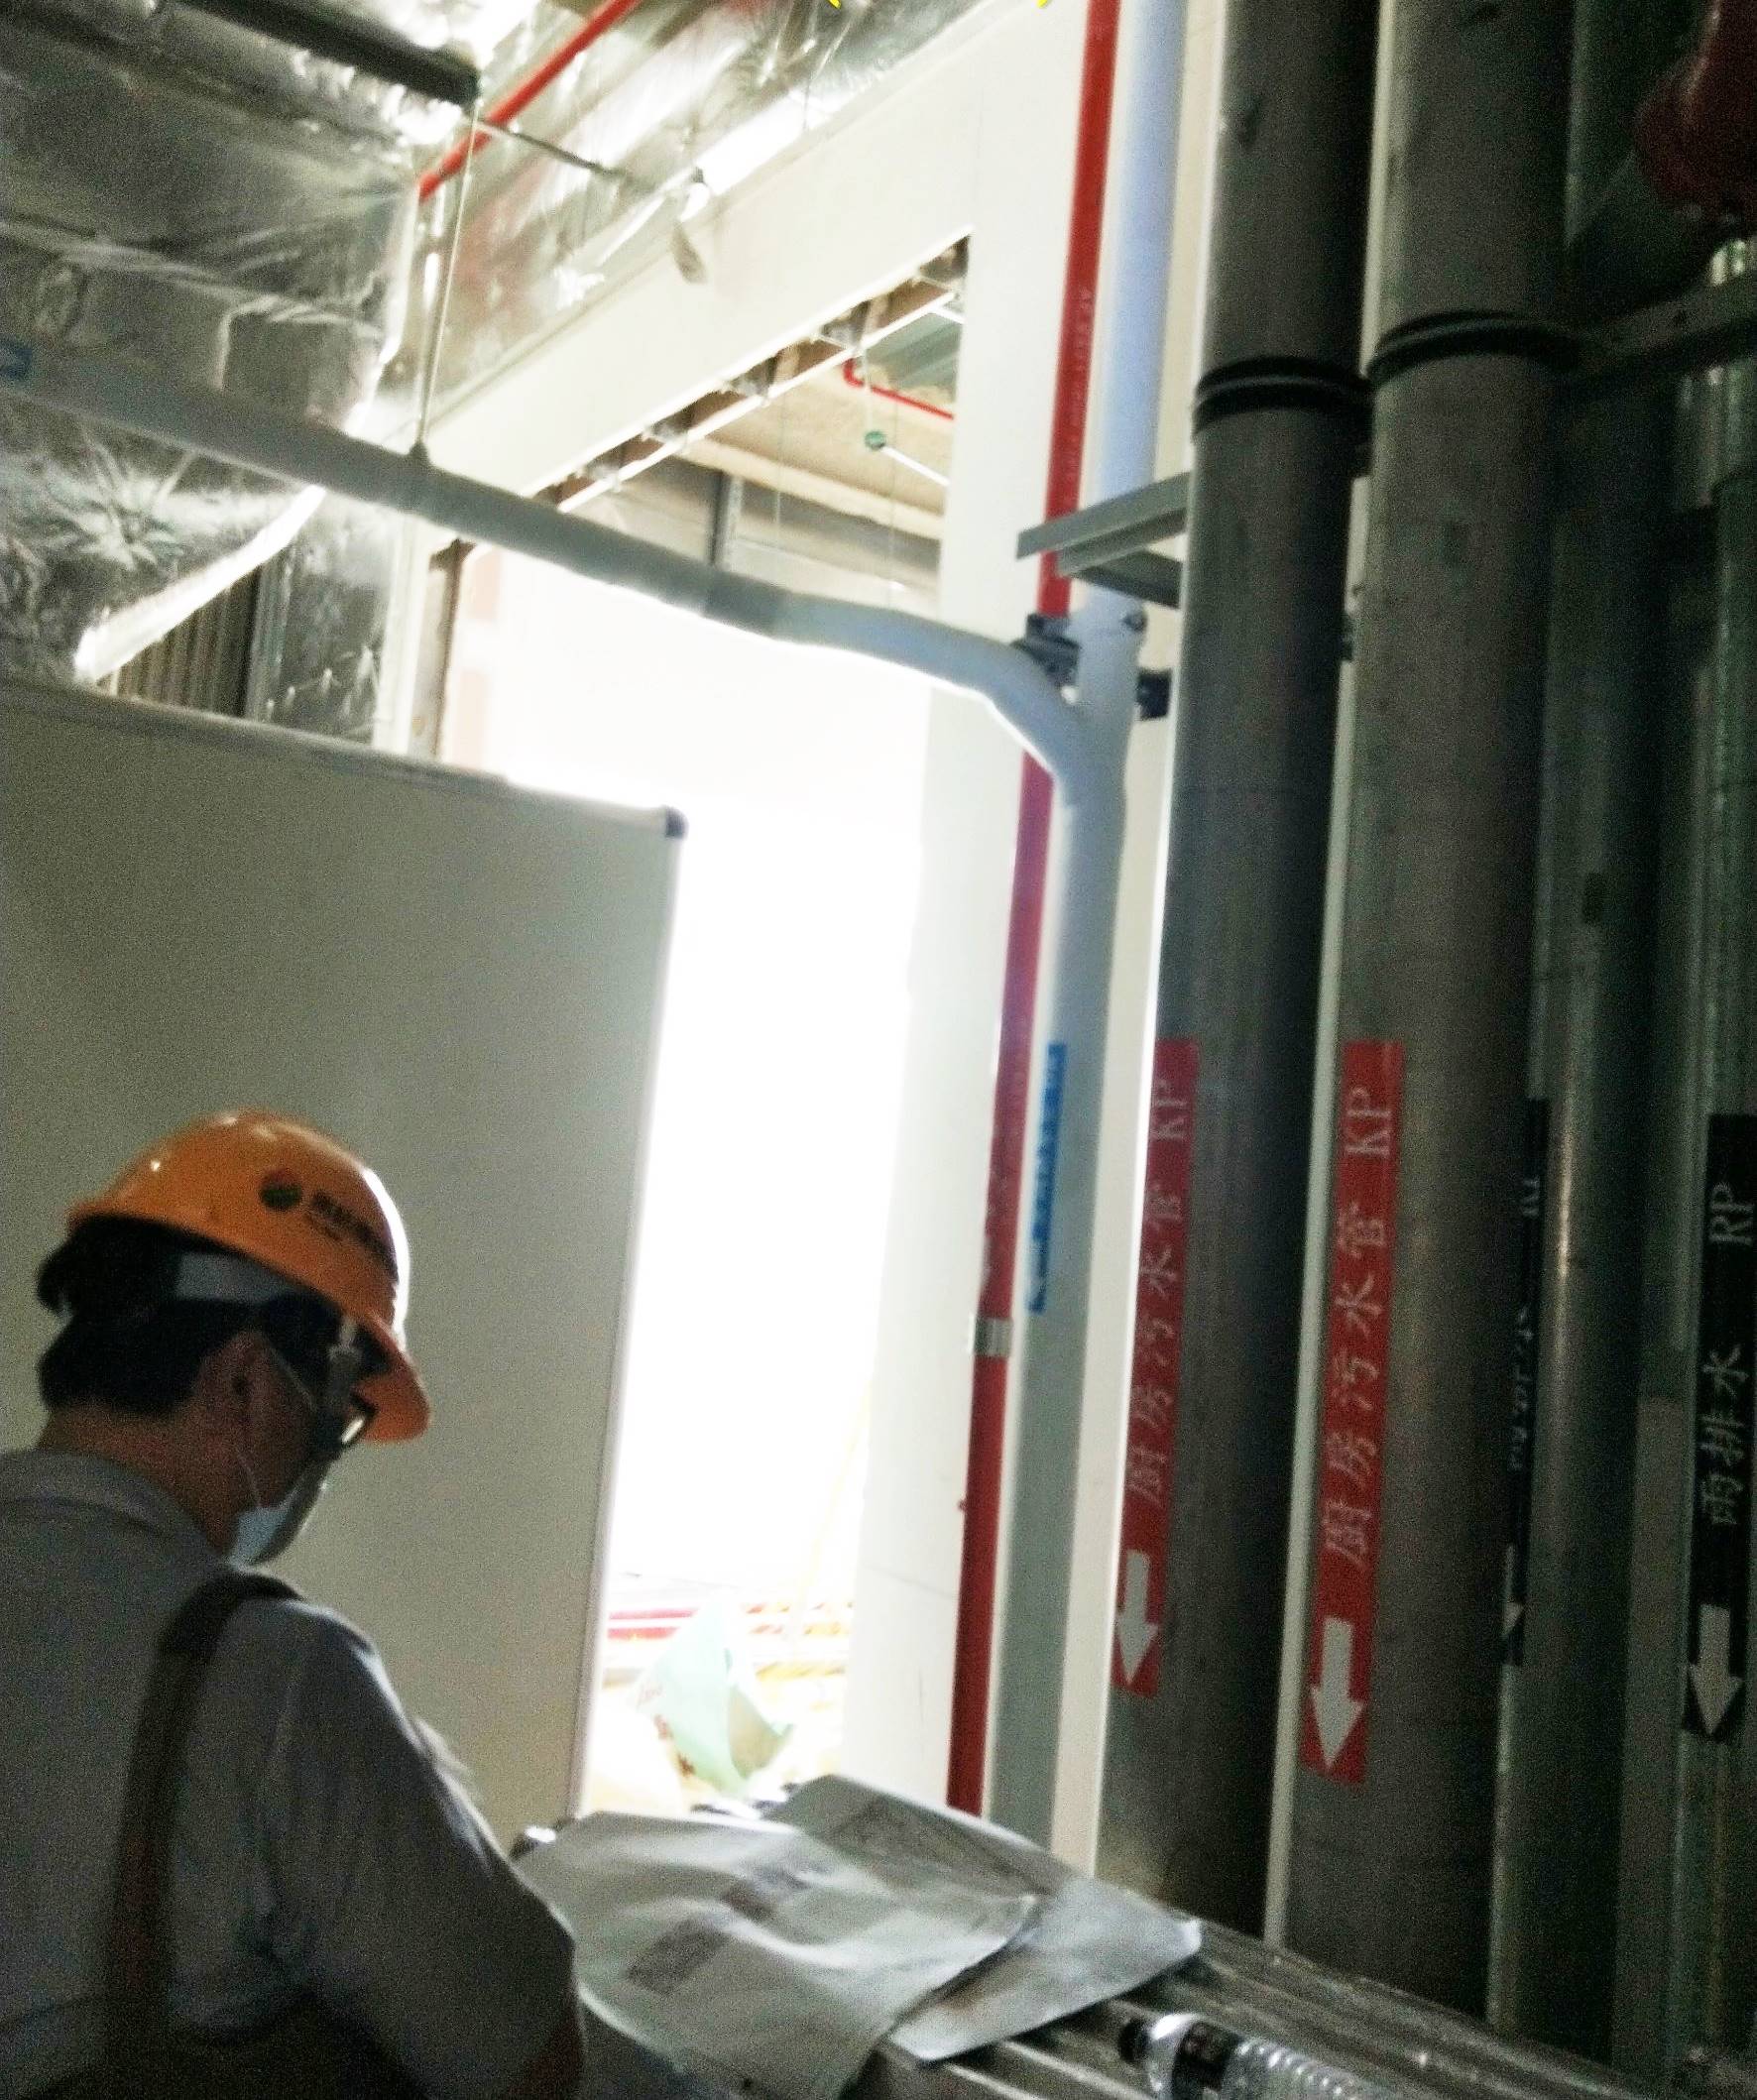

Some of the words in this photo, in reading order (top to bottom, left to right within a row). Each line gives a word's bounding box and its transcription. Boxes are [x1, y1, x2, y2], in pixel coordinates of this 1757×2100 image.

[1150, 1078, 1189, 1139] KP
[1345, 1086, 1390, 1158] KP
[1708, 1181, 1755, 1245] RP
[1699, 1344, 1750, 1525] 雨排水
